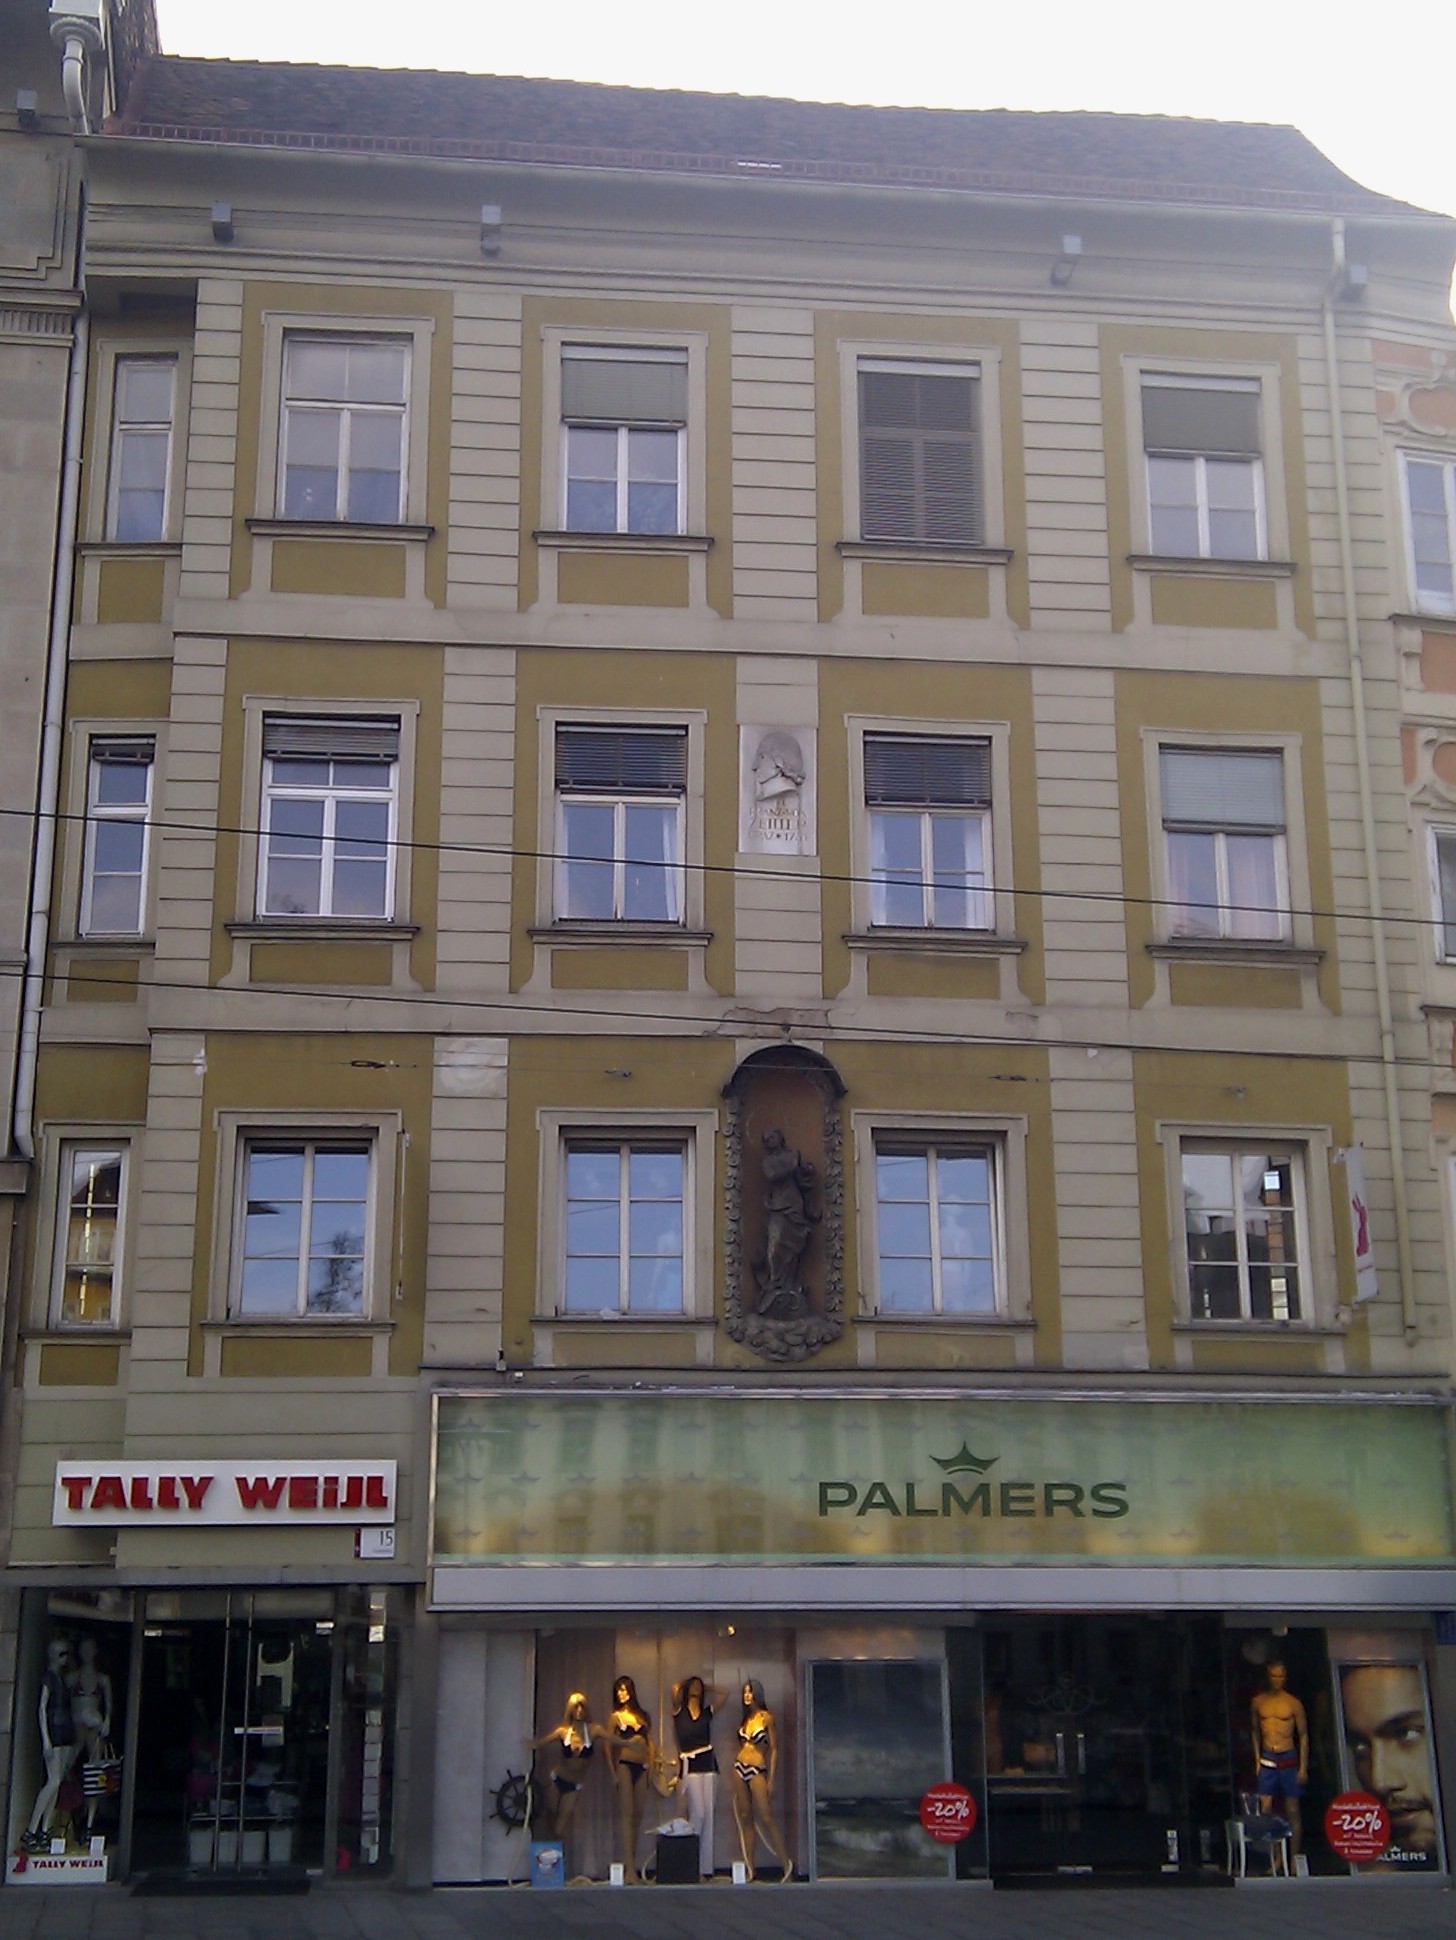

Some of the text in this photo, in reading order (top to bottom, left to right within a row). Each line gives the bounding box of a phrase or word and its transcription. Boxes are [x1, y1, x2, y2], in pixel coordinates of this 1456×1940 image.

[61, 1476, 214, 1509] TALLY
[818, 1481, 1130, 1518] PALMERS
[379, 1530, 394, 1547] 15
[927, 1800, 970, 1820] -20%
[1332, 1810, 1382, 1834] -20%
[33, 1860, 66, 1868] TALLY
[1377, 1852, 1427, 1861] ALMERS
